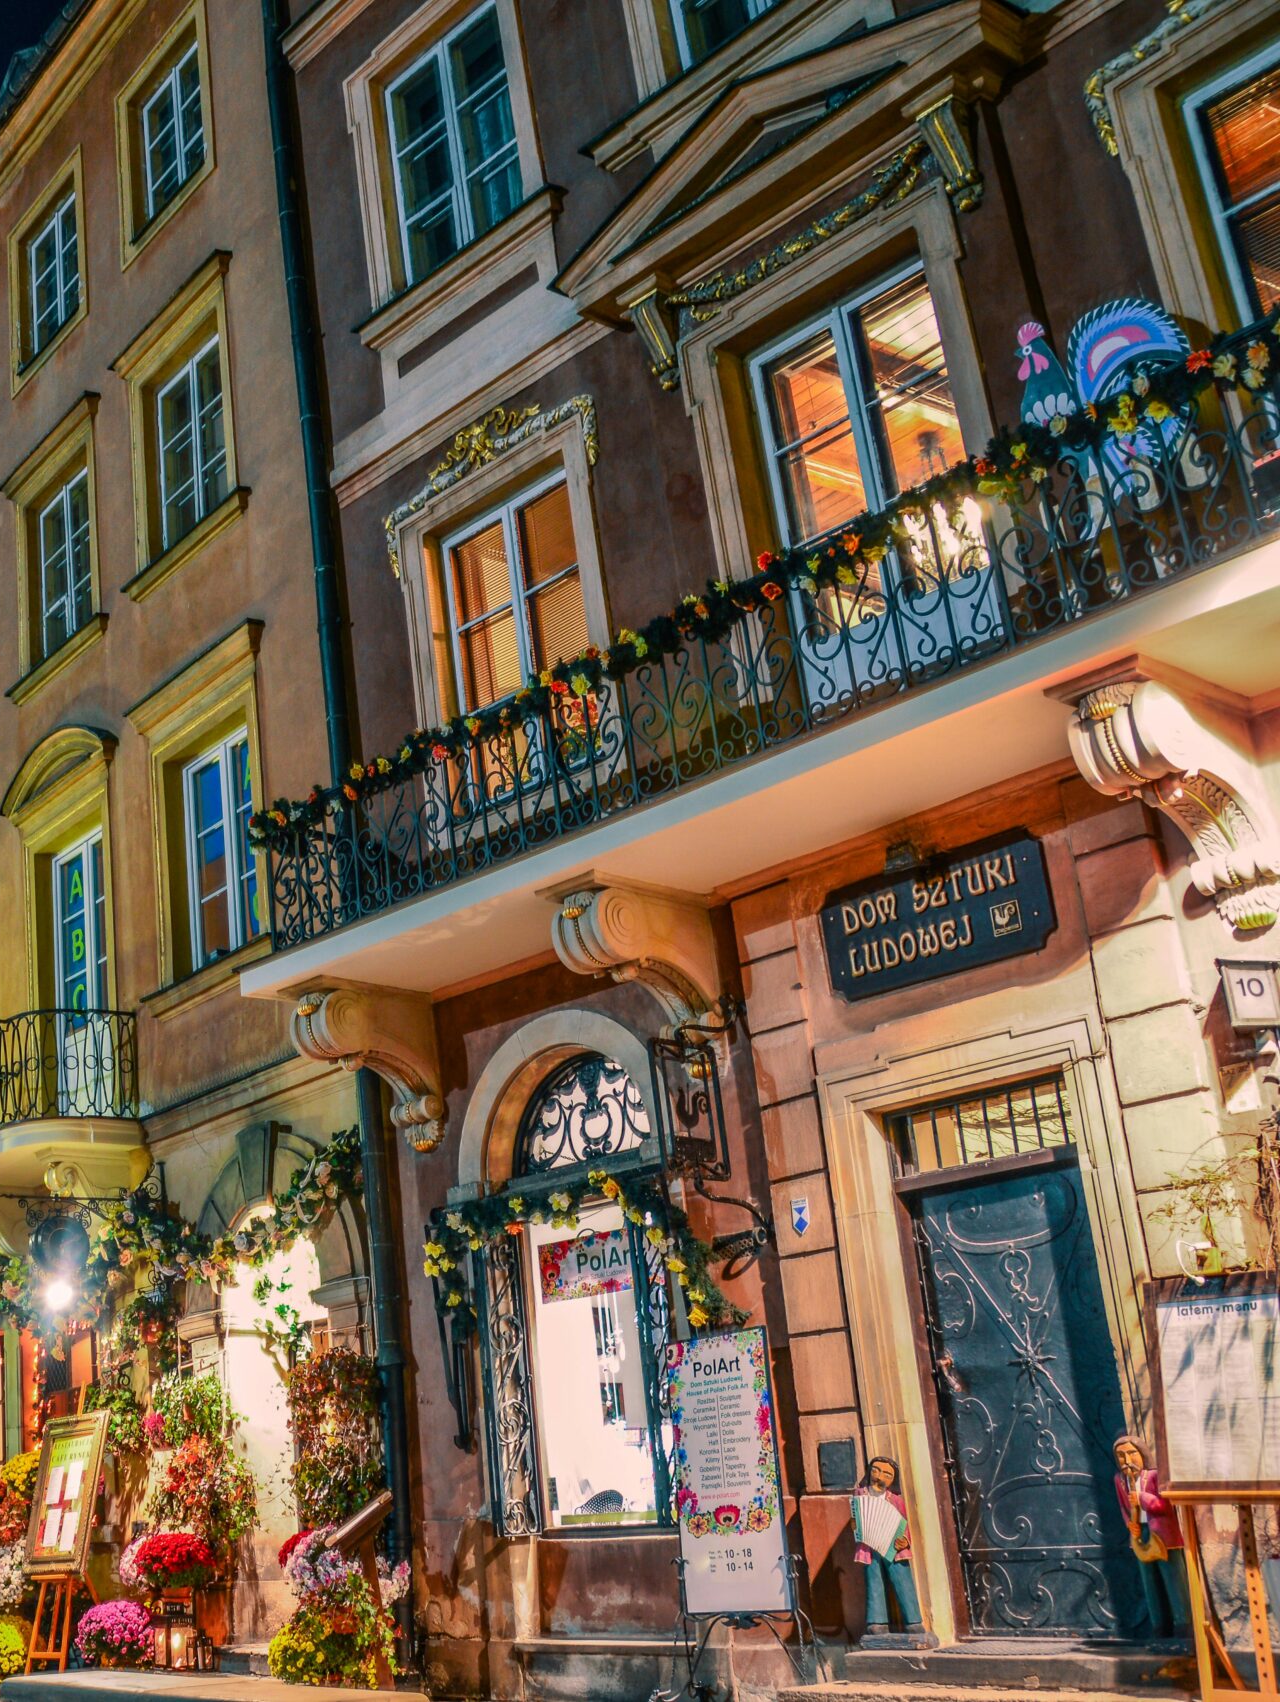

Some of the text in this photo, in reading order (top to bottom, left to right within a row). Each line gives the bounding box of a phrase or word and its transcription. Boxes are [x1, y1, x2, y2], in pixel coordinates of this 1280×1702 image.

[841, 854, 1017, 936] DOM SZTUKI
[849, 914, 974, 977] LUDOWEJ
[1236, 977, 1265, 998] 10
[1177, 1302, 1258, 1316] latem menu
[693, 1356, 741, 1378] PolArt
[720, 1375, 743, 1383] Ludowej
[693, 1406, 716, 1414] Ceramika
[698, 1414, 717, 1422] Ludowe
[693, 1423, 718, 1431] Wycinanki
[723, 1436, 751, 1444] Embroidery
[699, 1448, 720, 1456] Koronka
[727, 1480, 752, 1488] Souvenirs
[725, 1549, 735, 1559] 10
[742, 1548, 752, 1558] 18
[726, 1562, 736, 1572] 10
[744, 1561, 754, 1571] 14
